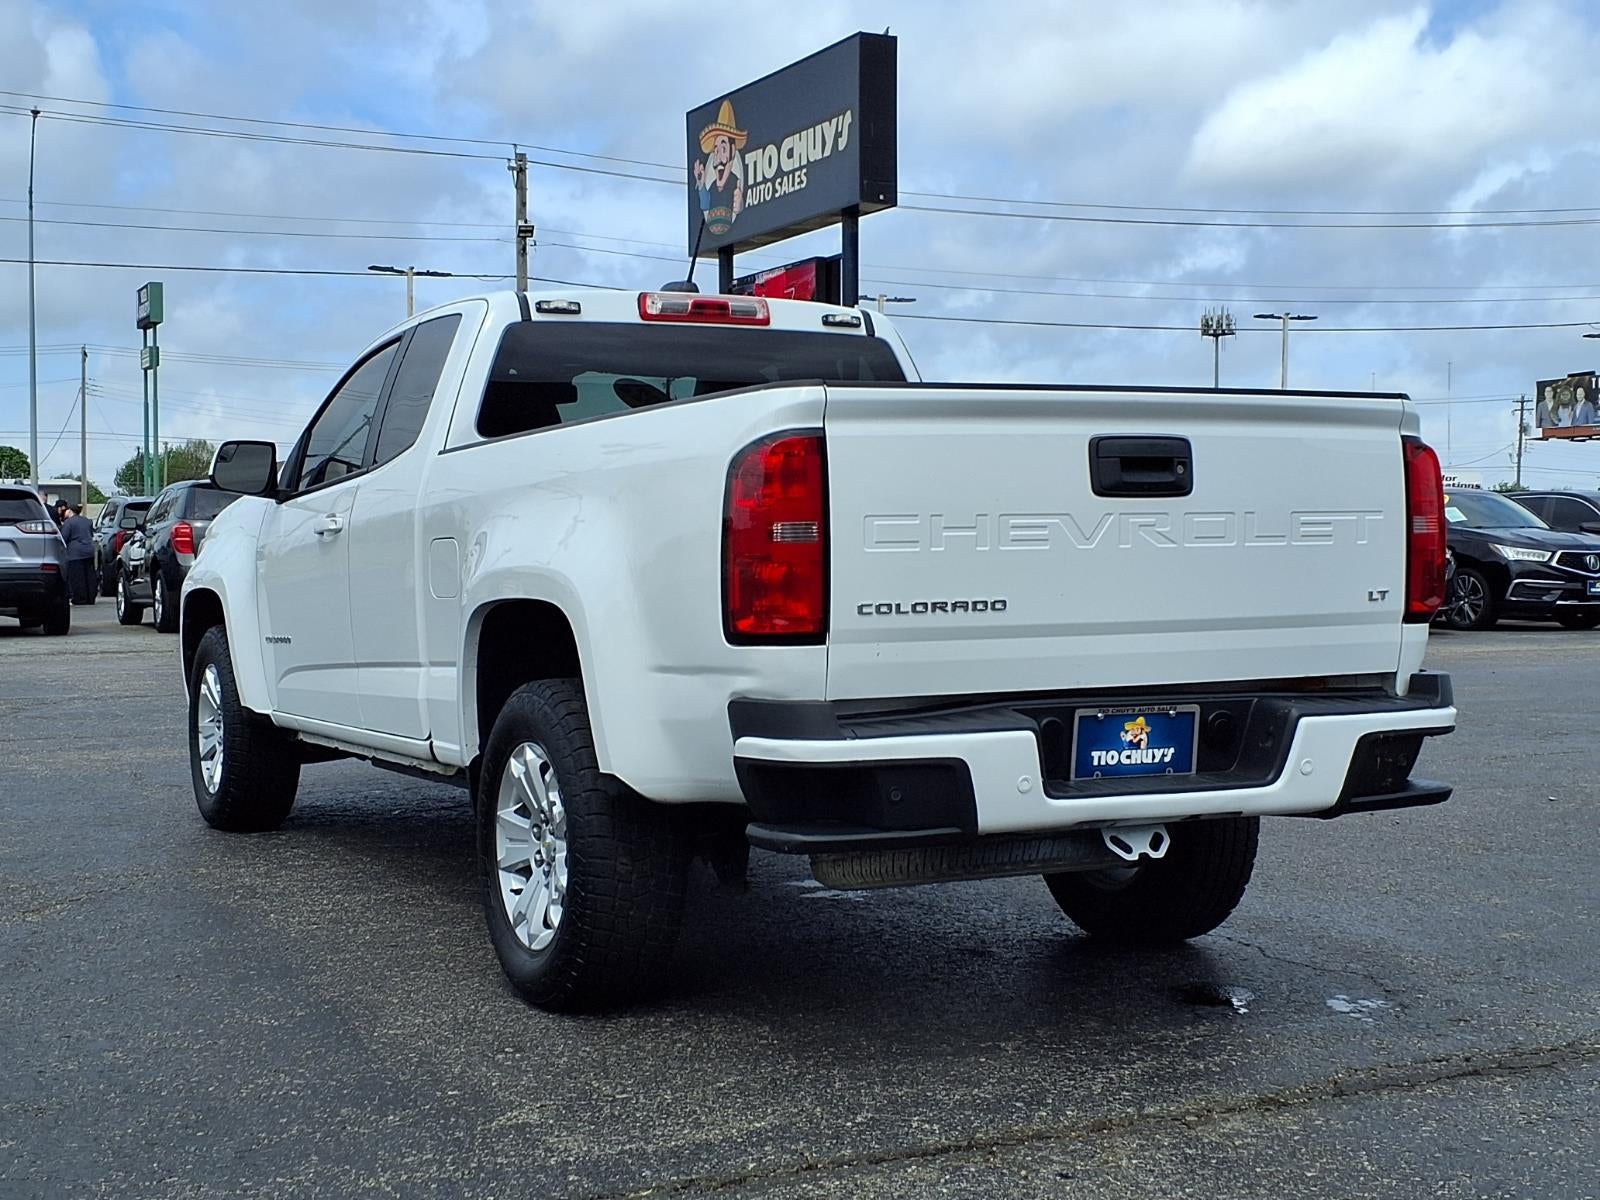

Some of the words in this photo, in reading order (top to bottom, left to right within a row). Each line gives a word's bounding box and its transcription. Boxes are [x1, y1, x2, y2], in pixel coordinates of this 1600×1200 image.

[745, 144, 778, 186] TIO
[780, 110, 852, 172] CHUY'S
[745, 182, 773, 208] AUTO
[775, 168, 807, 197] SALES
[863, 510, 1385, 552] CHEVROLET
[856, 598, 1008, 616] COLORADO
[1368, 590, 1390, 601] LT
[1091, 750, 1120, 766] TIO
[1120, 747, 1175, 764] CHUY'S
